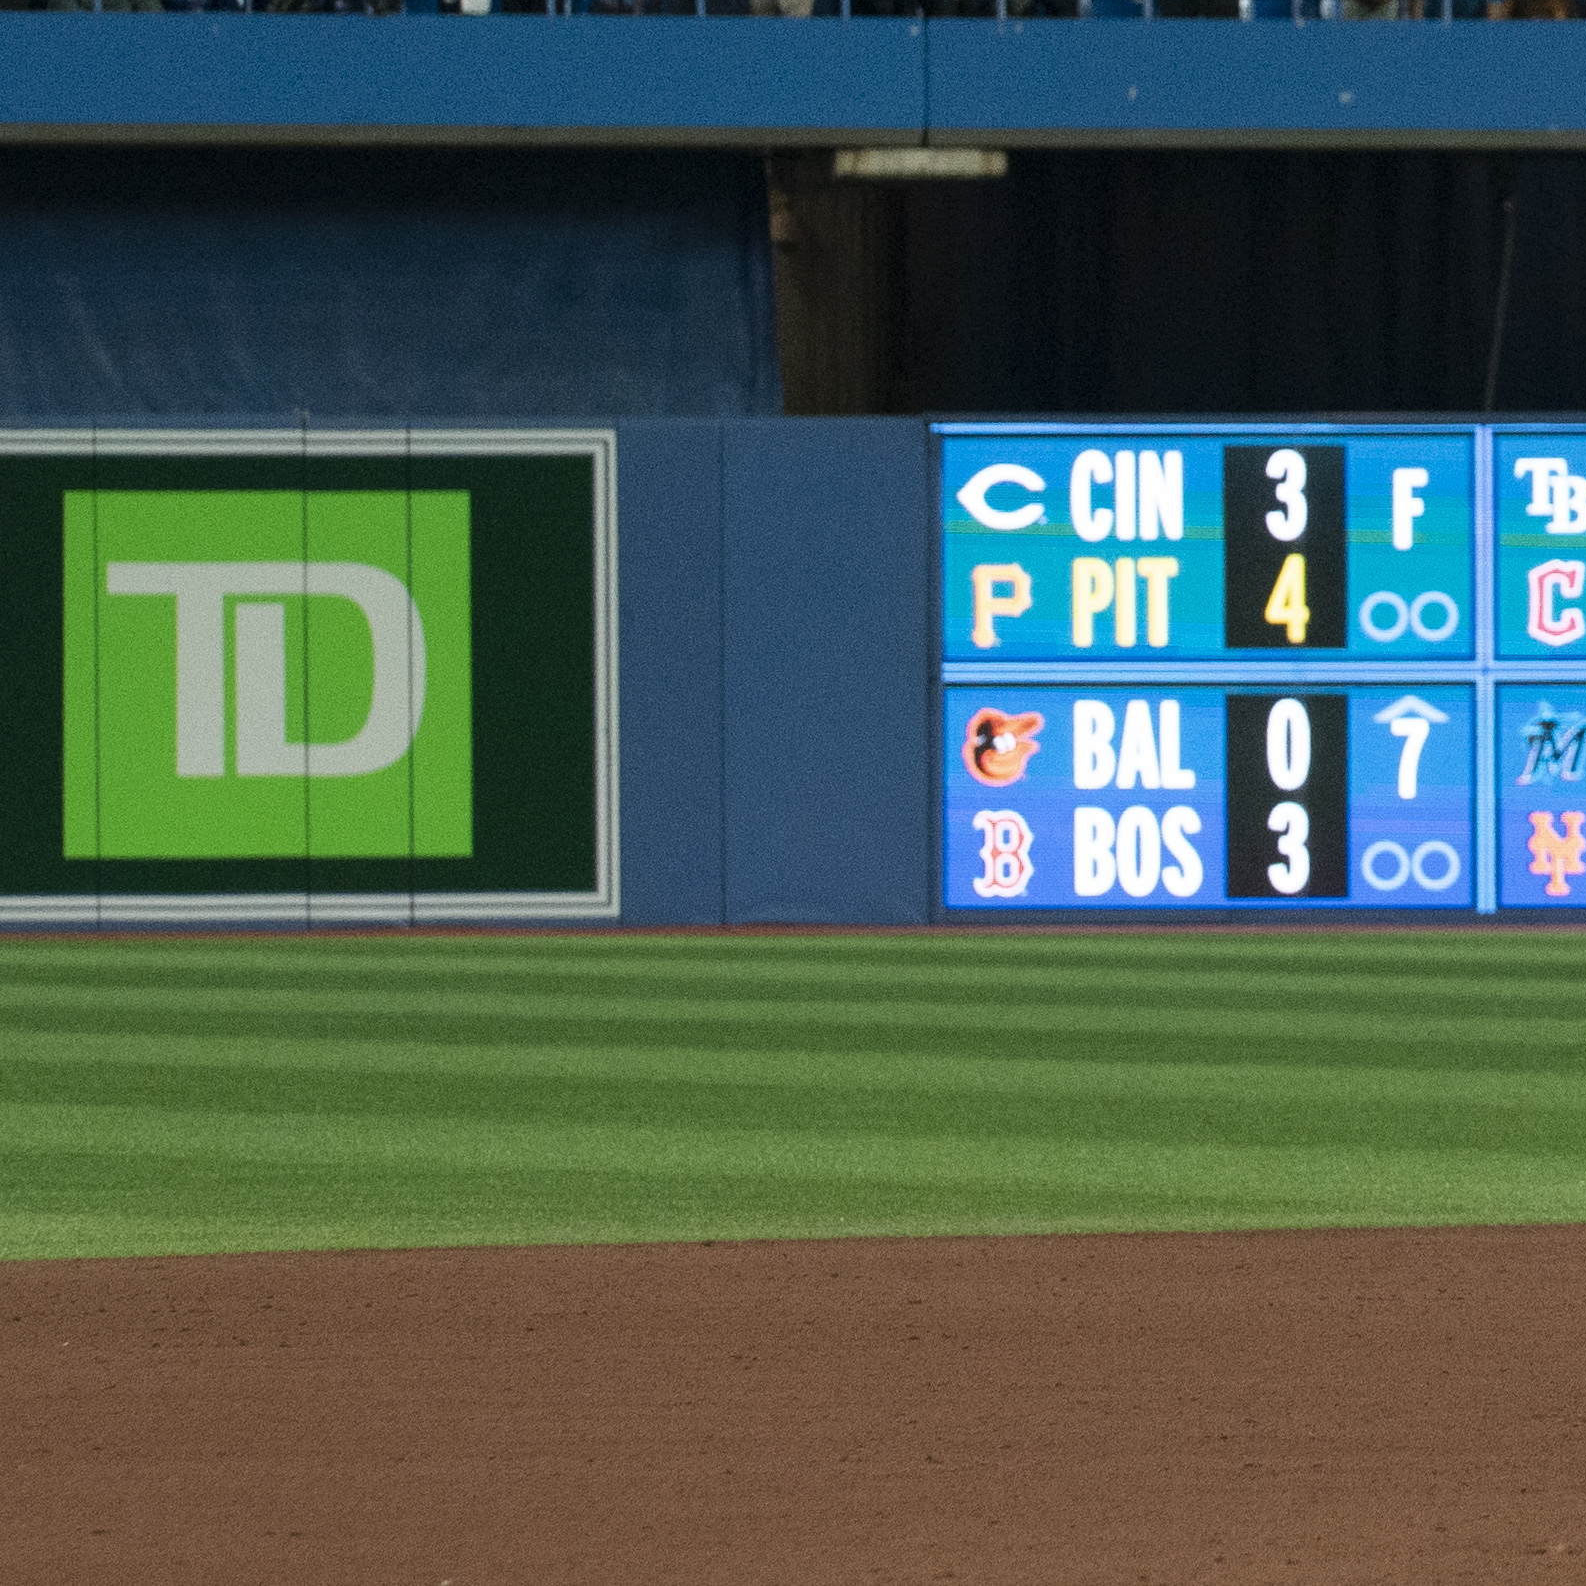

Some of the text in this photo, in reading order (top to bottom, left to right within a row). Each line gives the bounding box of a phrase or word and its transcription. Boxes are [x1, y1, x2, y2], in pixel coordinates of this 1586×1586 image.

[1070, 449, 1429, 550] CIN 3 F
[1071, 553, 1310, 648] PIT 4
[107, 561, 427, 777] TD
[1073, 698, 1430, 799] BAL 0 7
[1073, 802, 1310, 898] BOS 3
